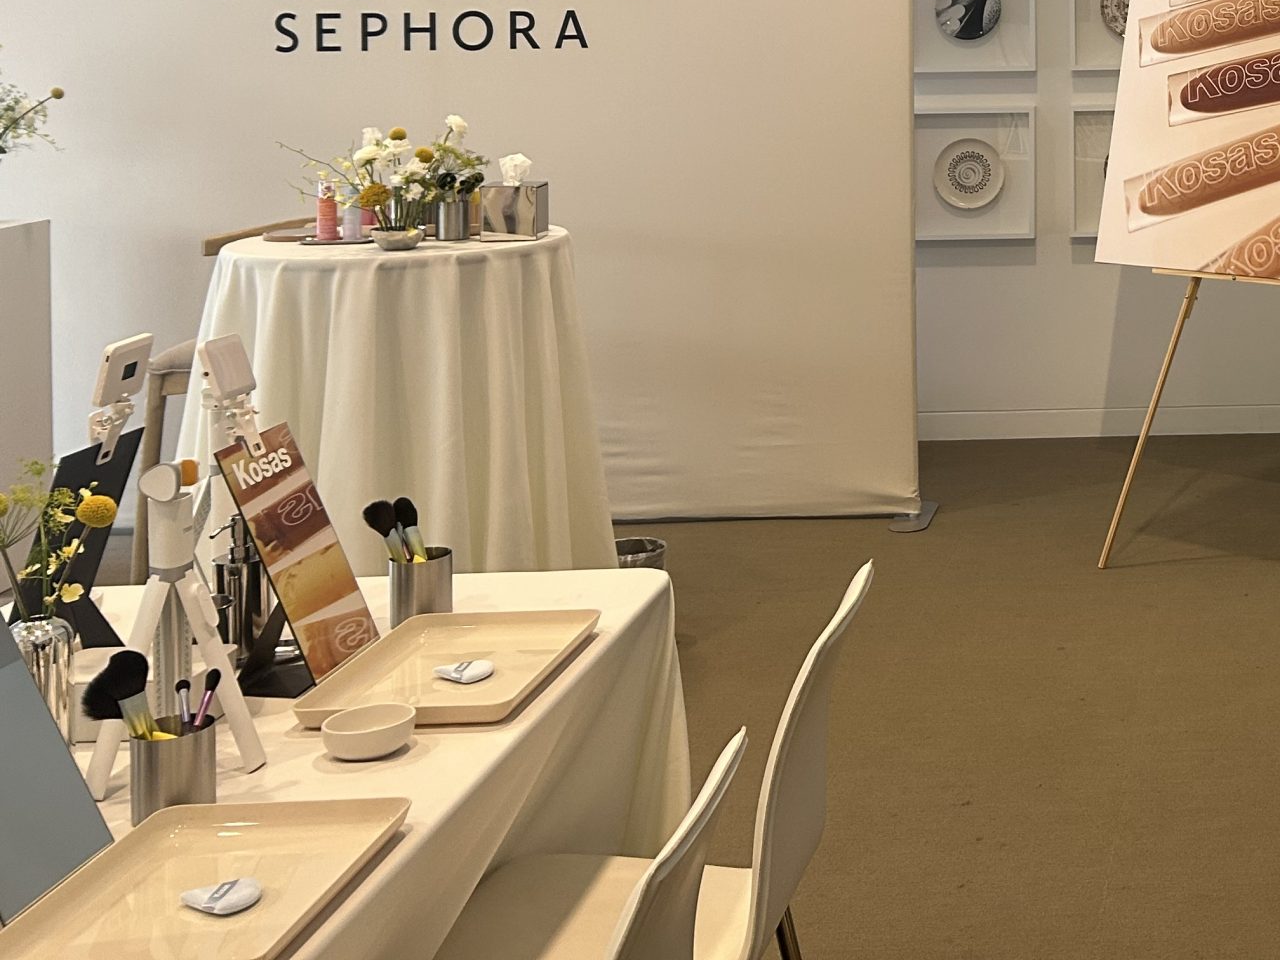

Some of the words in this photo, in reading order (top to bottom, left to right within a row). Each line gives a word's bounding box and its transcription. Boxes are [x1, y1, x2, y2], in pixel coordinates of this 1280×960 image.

[274, 9, 590, 53] SEPHORA
[1143, 132, 1280, 207] Kosas
[231, 446, 293, 490] Kosas
